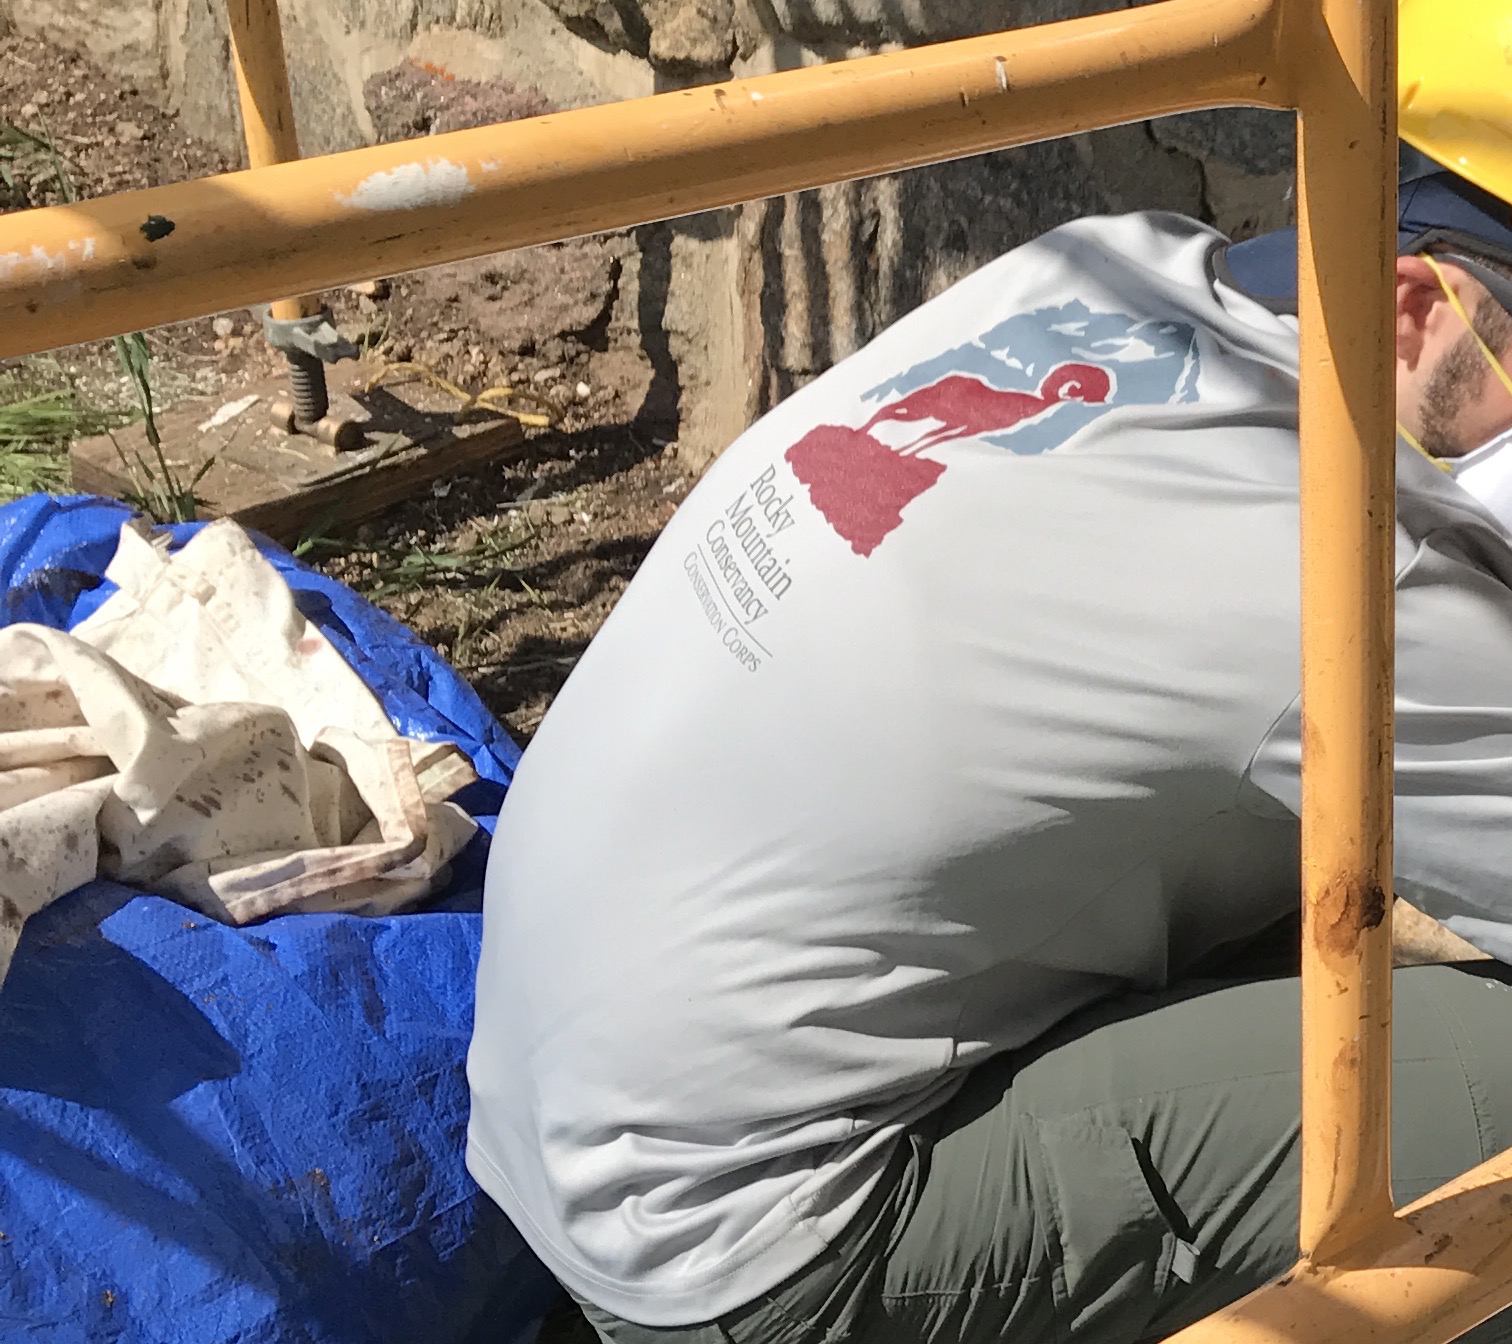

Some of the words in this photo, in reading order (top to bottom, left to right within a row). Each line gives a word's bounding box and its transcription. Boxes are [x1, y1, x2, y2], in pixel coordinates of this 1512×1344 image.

[725, 490, 792, 600] Mountain
[750, 463, 795, 538] Rocky
[683, 551, 727, 634] CONSERVATION
[722, 627, 761, 672] CORPS
[706, 519, 769, 625] Conservancy
